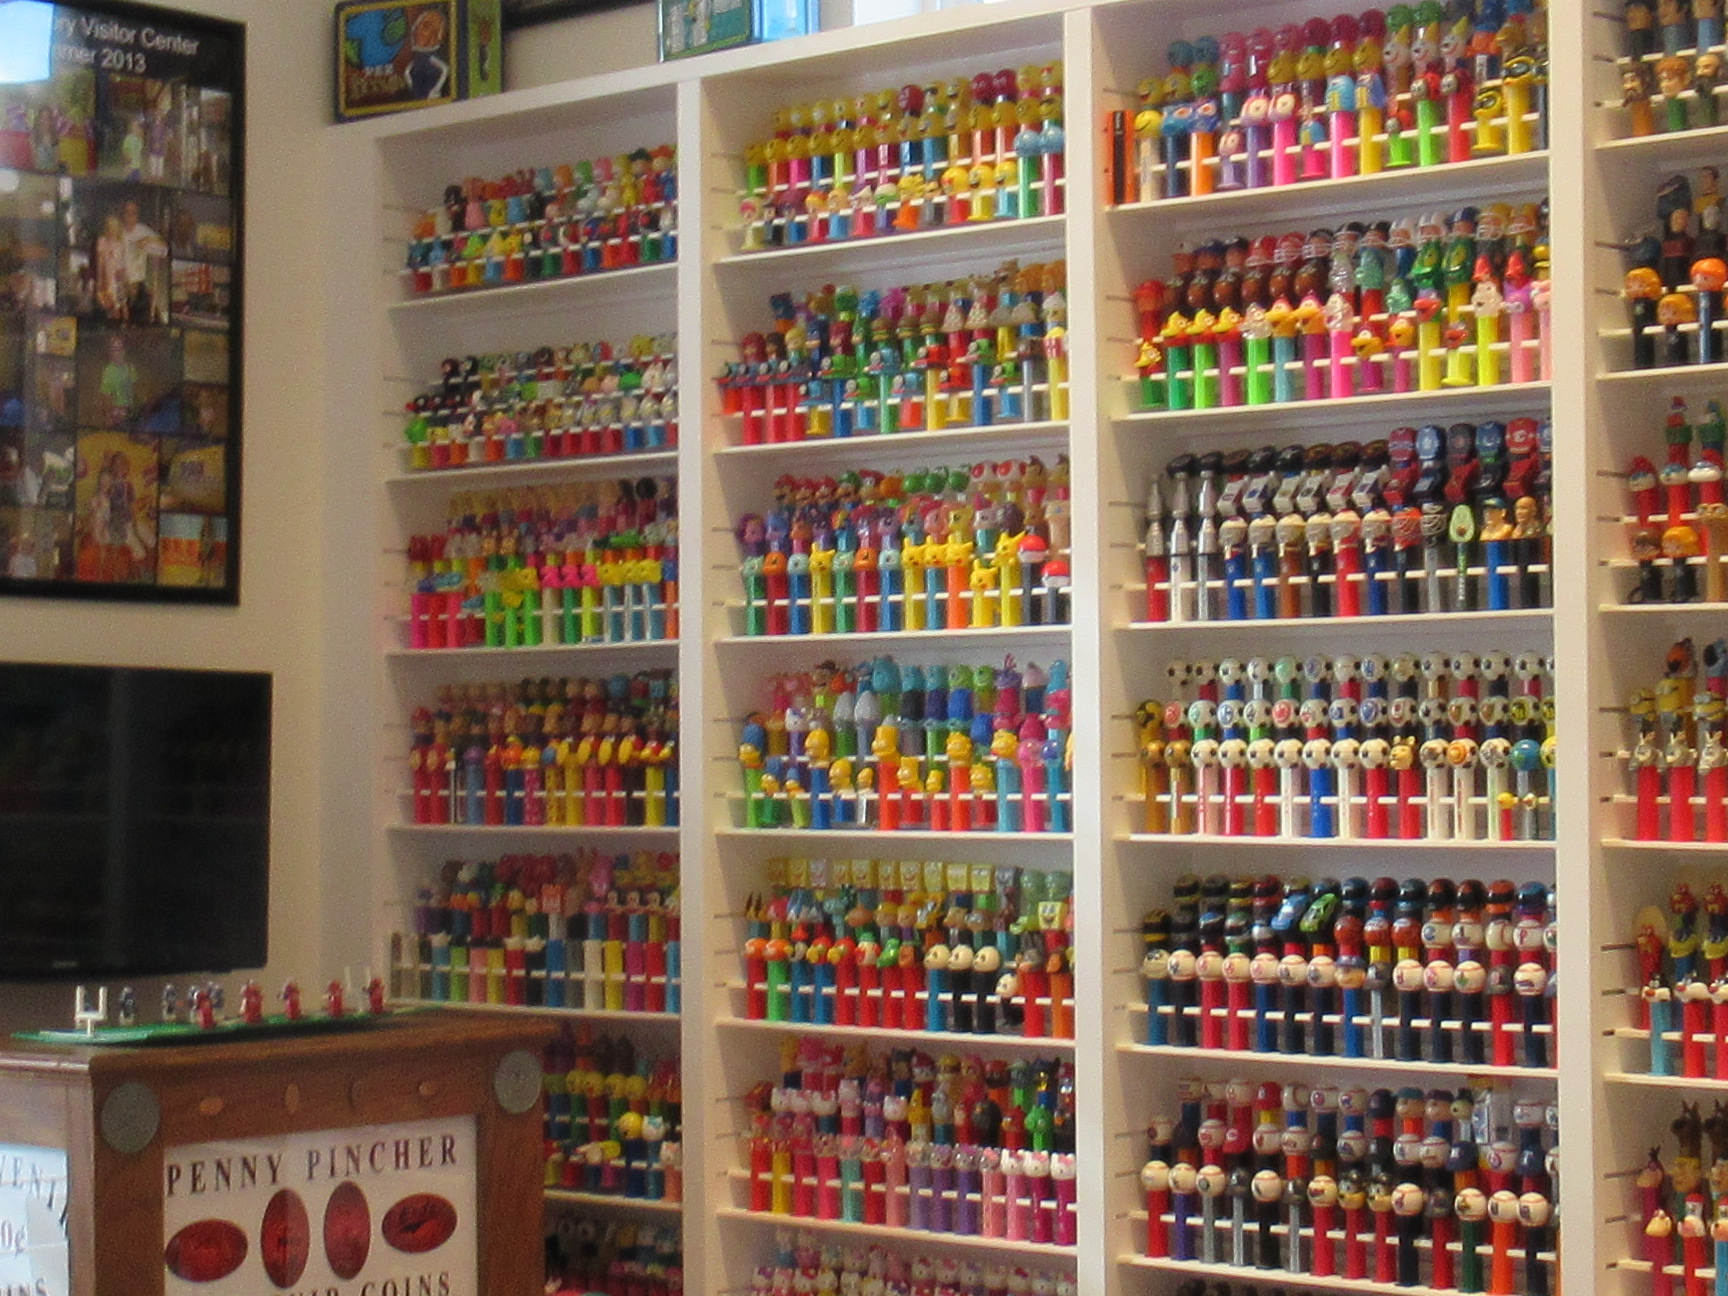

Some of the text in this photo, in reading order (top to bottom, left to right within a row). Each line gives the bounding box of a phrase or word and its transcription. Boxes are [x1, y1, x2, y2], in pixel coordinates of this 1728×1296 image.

[81, 15, 136, 45] Visitor
[140, 27, 200, 55] Center
[101, 49, 147, 74] 2013
[165, 1133, 459, 1198] PENNY PINCHER
